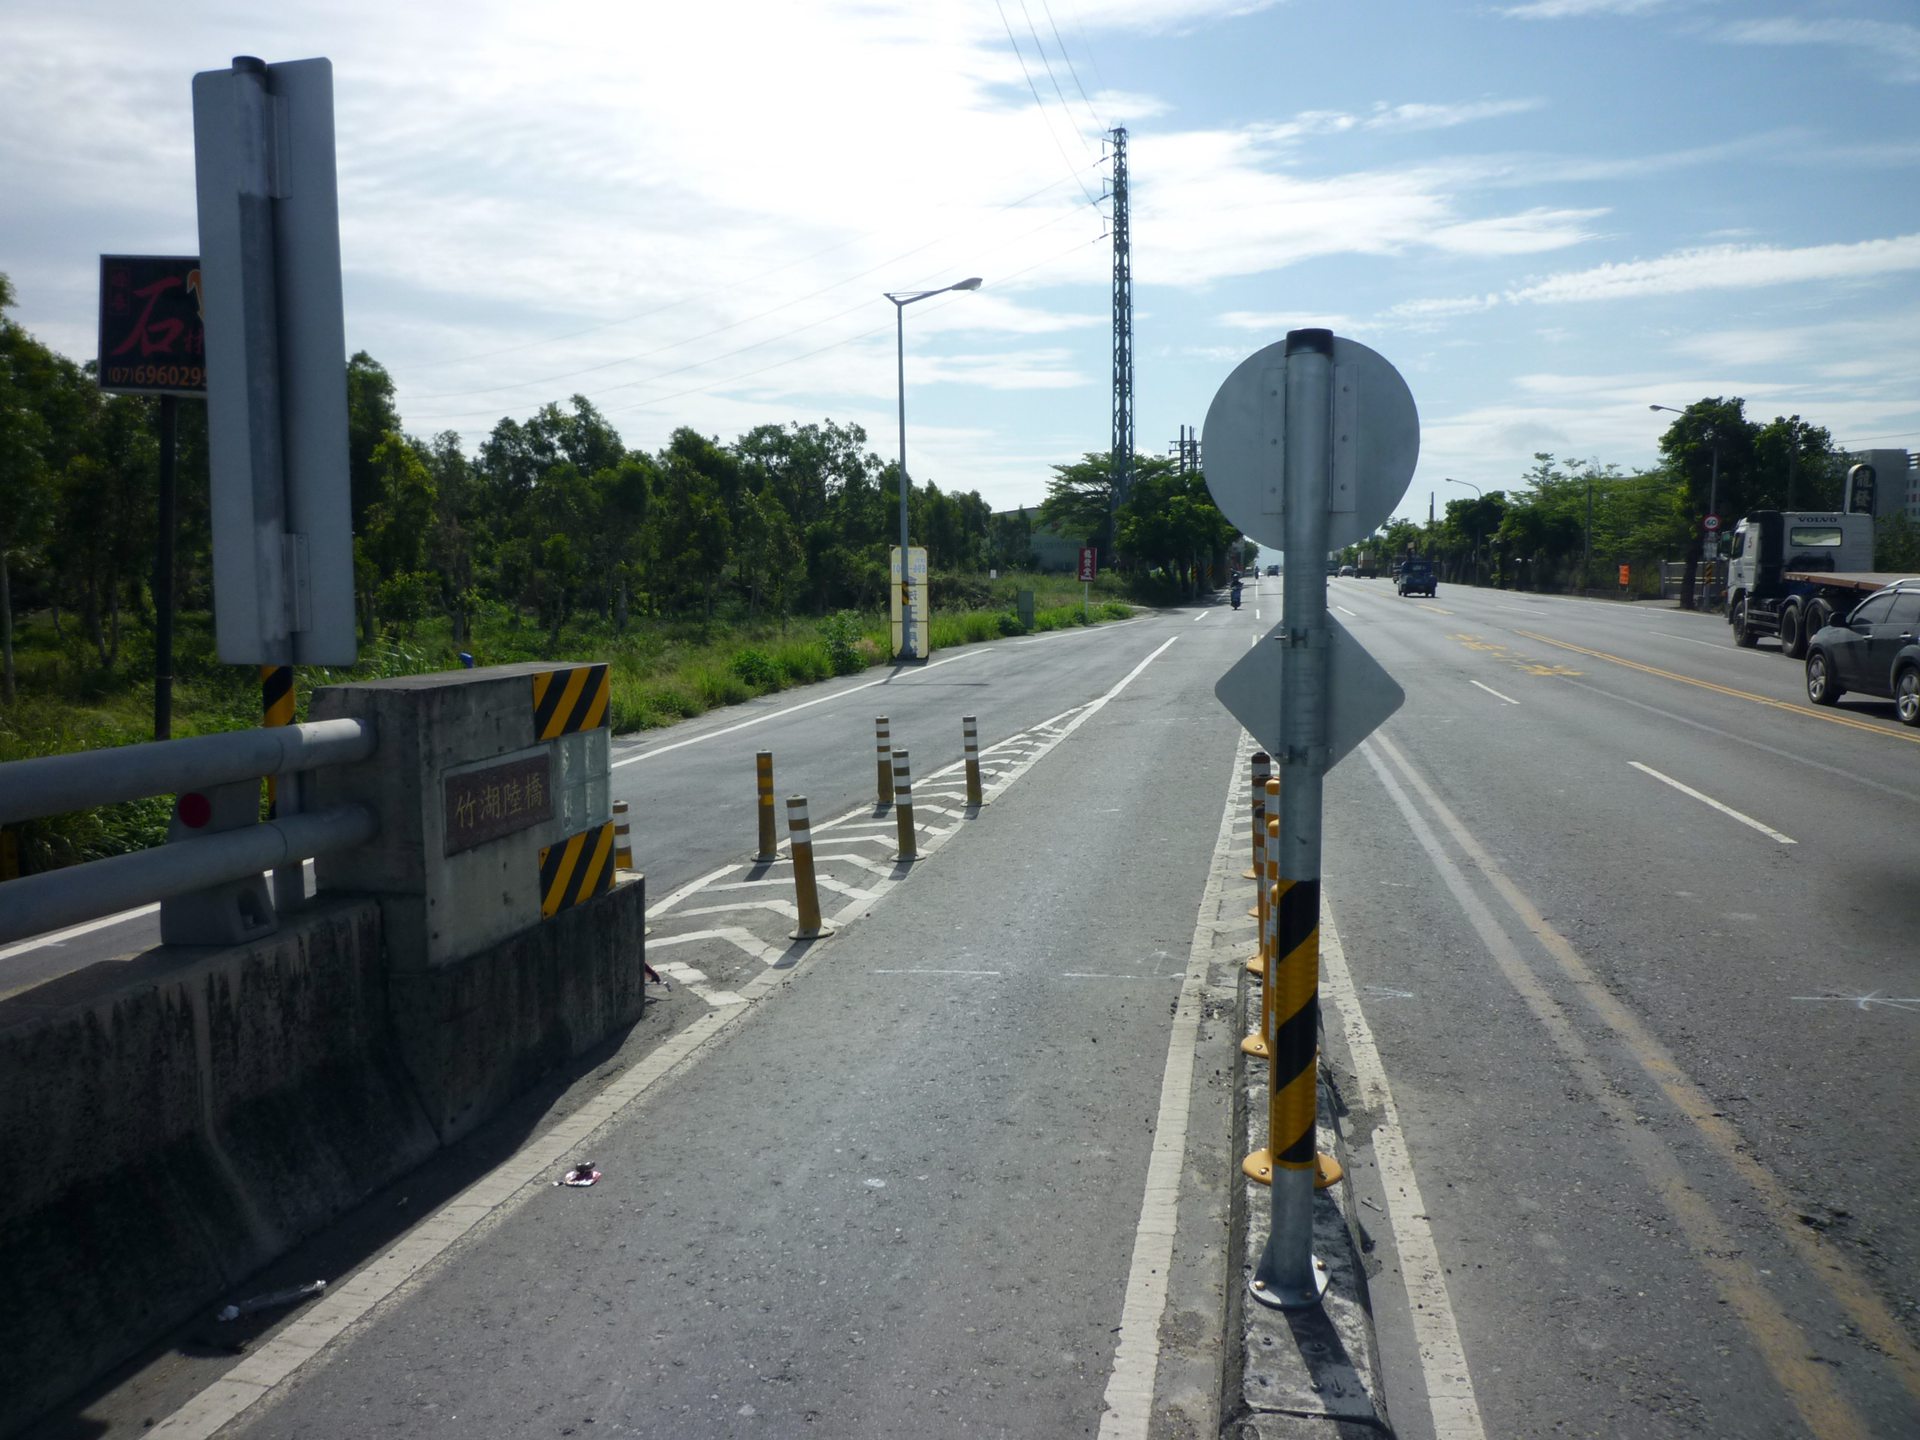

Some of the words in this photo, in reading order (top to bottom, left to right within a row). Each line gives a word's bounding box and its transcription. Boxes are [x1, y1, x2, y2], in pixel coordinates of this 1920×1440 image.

[108, 364, 207, 386] (07)696029
[455, 773, 543, 829] 竹湖陸橋
